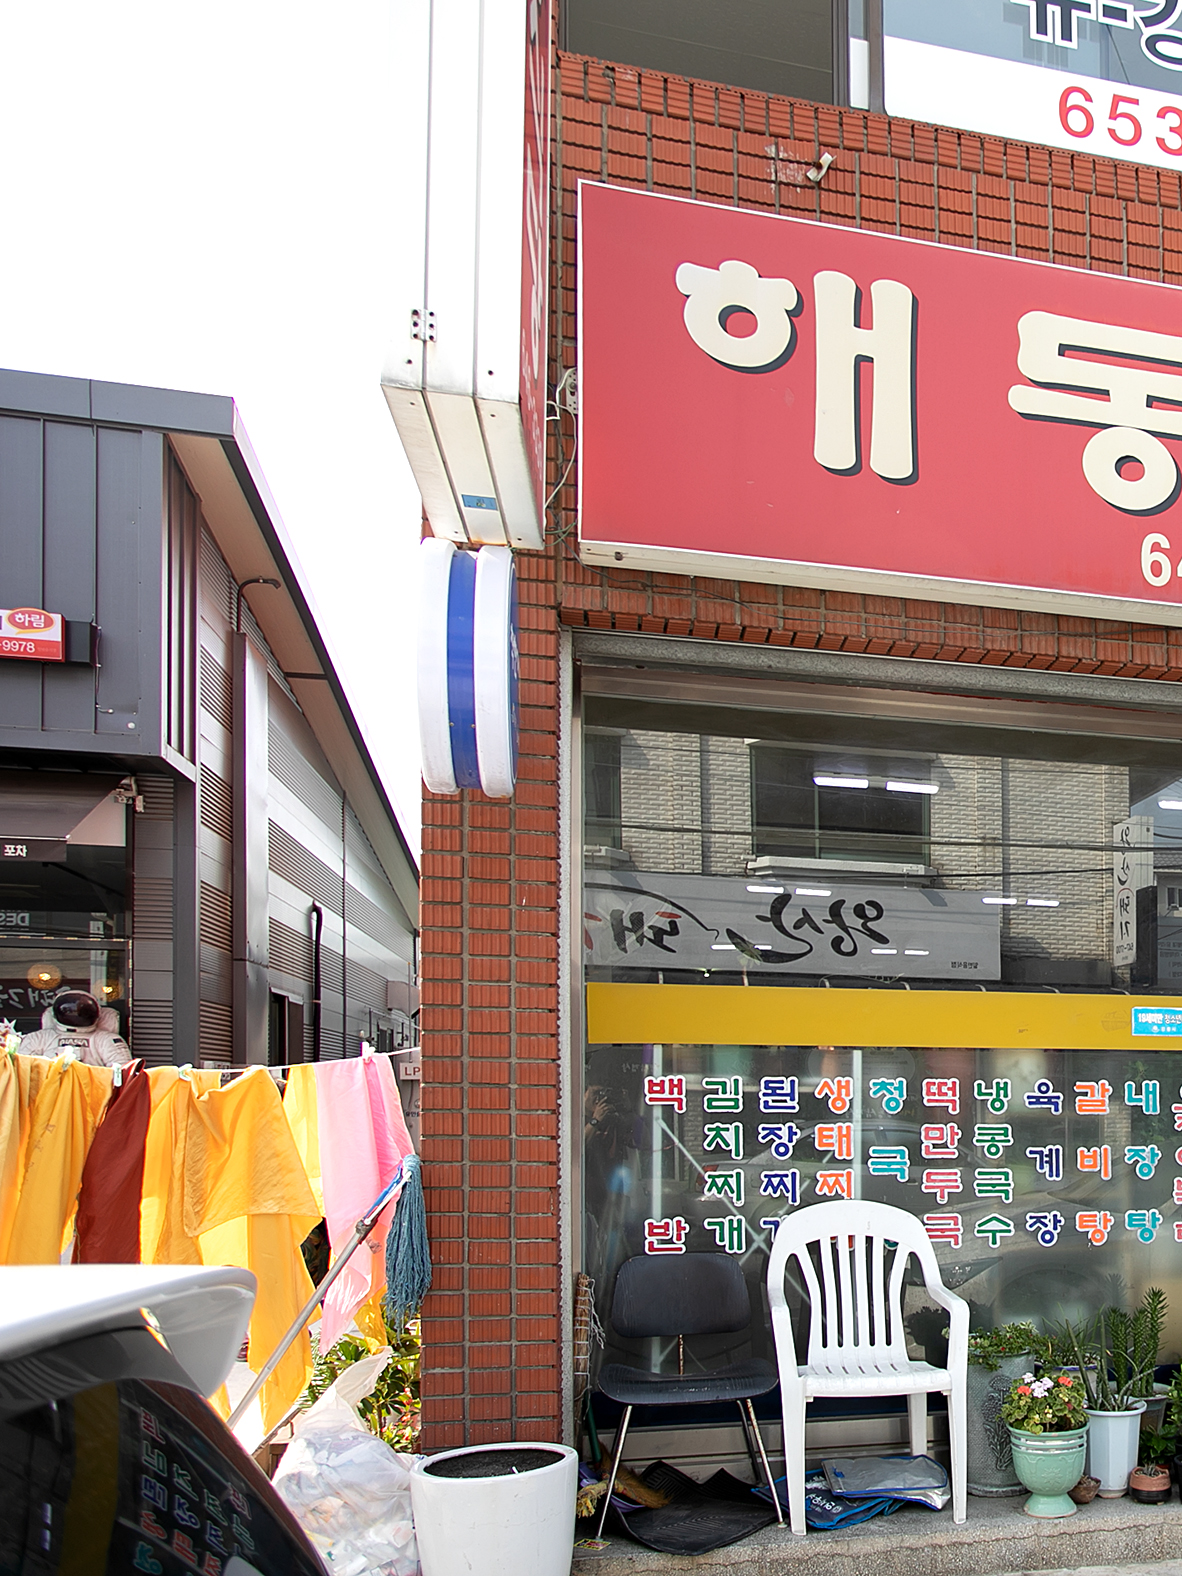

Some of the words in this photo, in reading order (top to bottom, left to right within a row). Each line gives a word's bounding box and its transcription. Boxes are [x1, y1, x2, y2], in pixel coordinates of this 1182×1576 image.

[14, 612, 45, 629] 하림
[4, 844, 28, 858] 포차
[644, 1075, 689, 1255] 백반
[703, 1075, 747, 1253] 김치찌개
[920, 1076, 964, 1249] 떡만두국
[973, 1076, 1015, 1249] 냉콩국수
[1023, 1078, 1065, 1248] 육계장
[1073, 1079, 1115, 1247] 갈비탕
[1124, 1079, 1163, 1245] 내장탕
